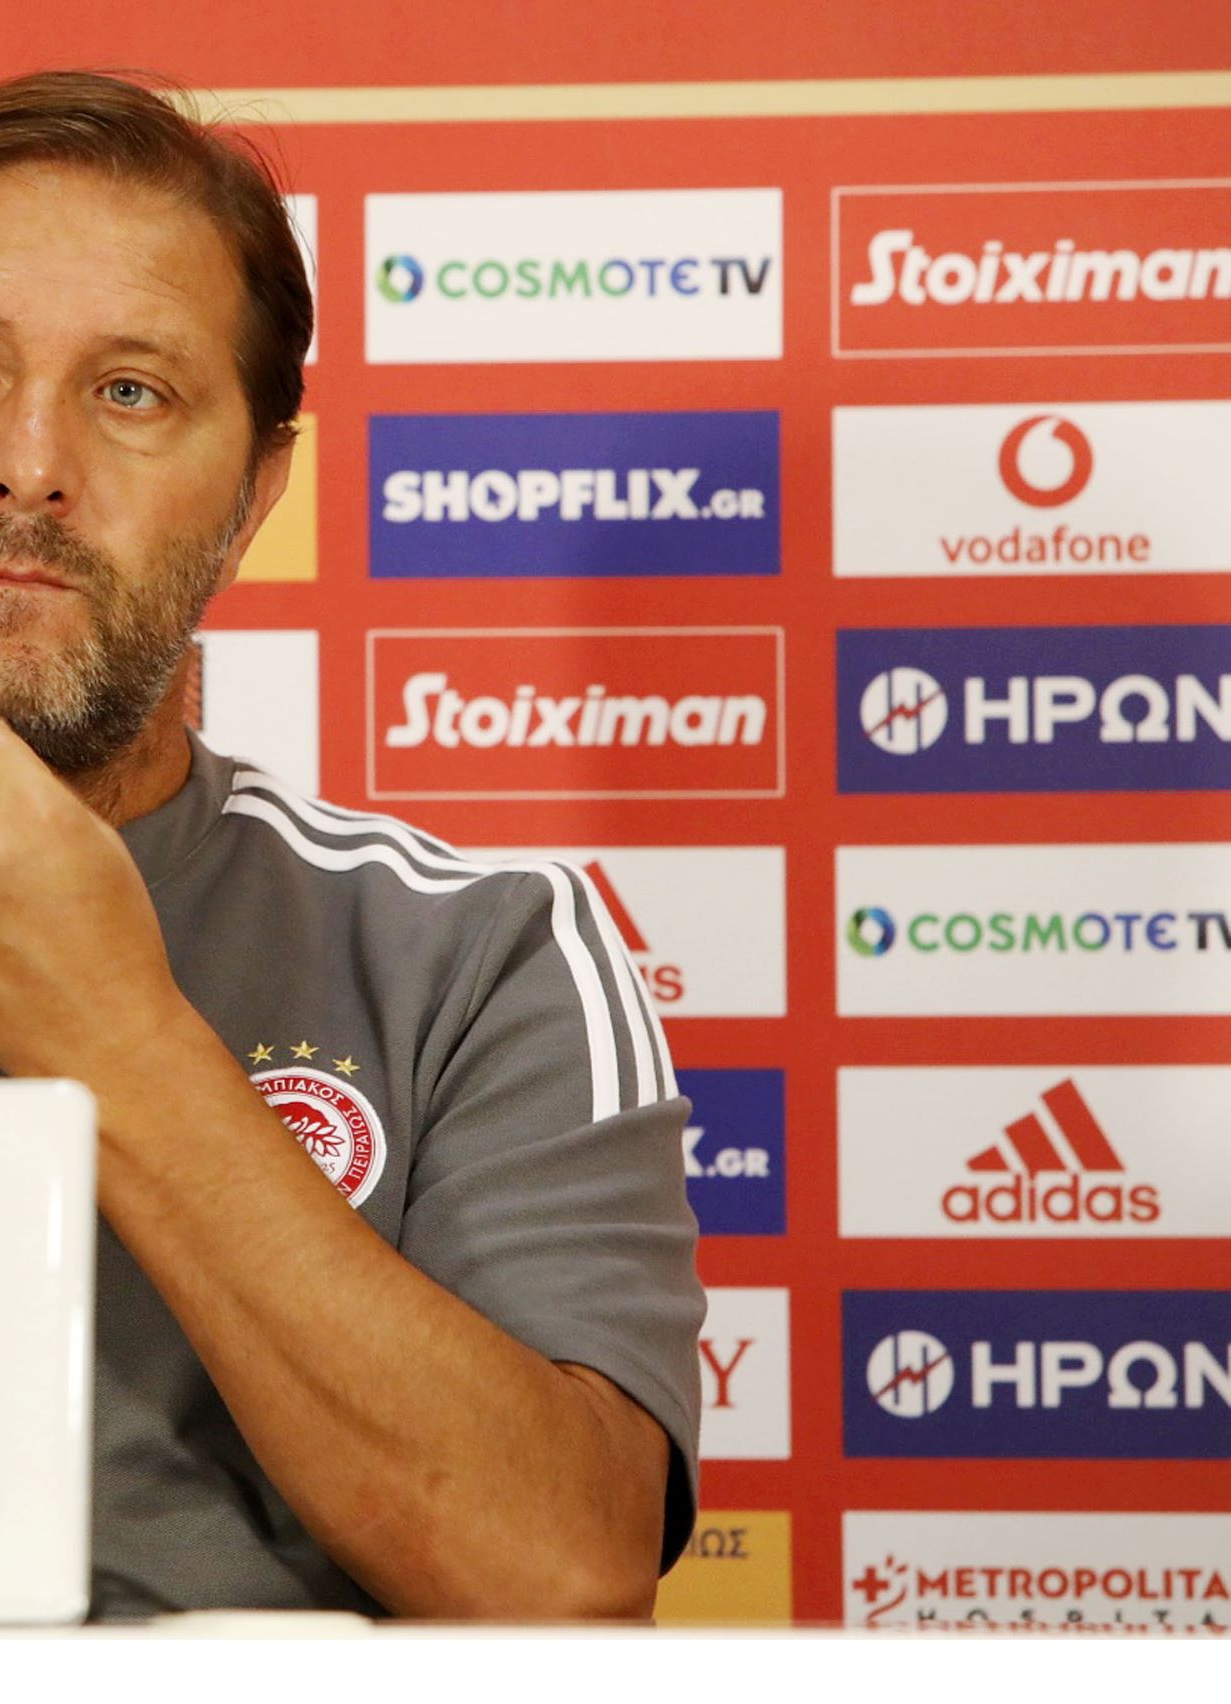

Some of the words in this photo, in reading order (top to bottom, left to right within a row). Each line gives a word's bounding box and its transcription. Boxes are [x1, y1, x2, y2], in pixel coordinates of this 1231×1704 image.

[436, 258, 700, 299] COSMOTE
[711, 257, 772, 296] TV
[383, 468, 764, 523] SHOPFLIX.GR
[940, 524, 1151, 565] vodafone
[385, 672, 767, 749] Stoiximan
[907, 912, 1178, 952] COSMOTE
[941, 1168, 1161, 1224] adidas
